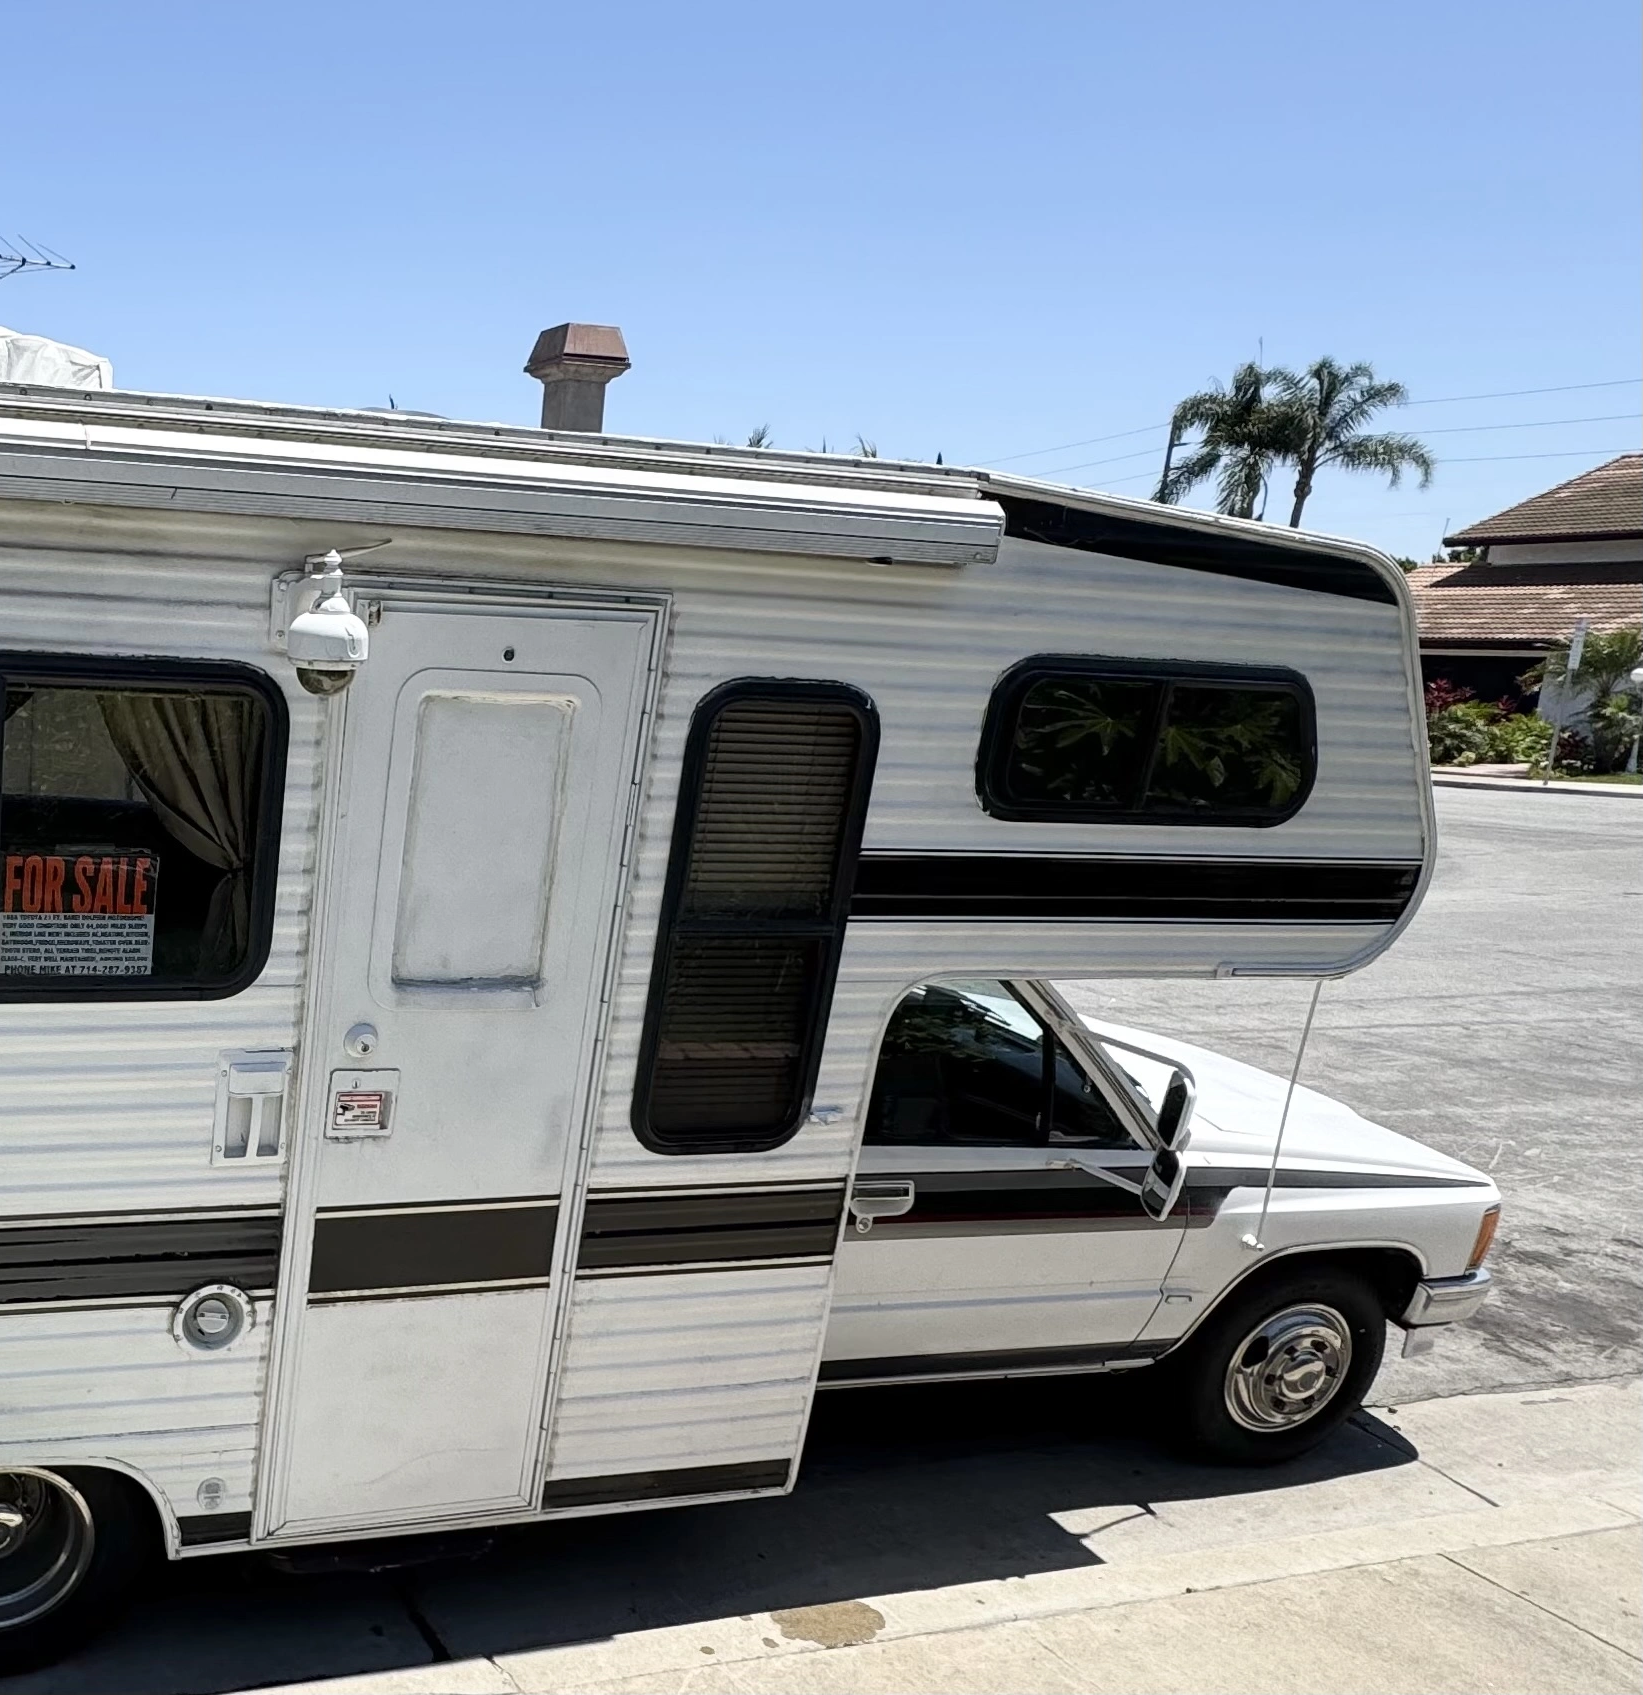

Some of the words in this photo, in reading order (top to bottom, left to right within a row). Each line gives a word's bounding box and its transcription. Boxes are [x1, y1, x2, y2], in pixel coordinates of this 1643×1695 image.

[4, 855, 65, 913] FOR
[72, 855, 150, 914] SALE
[5, 964, 36, 975] PHONE
[39, 965, 62, 975] MIKE
[64, 965, 77, 975] AT
